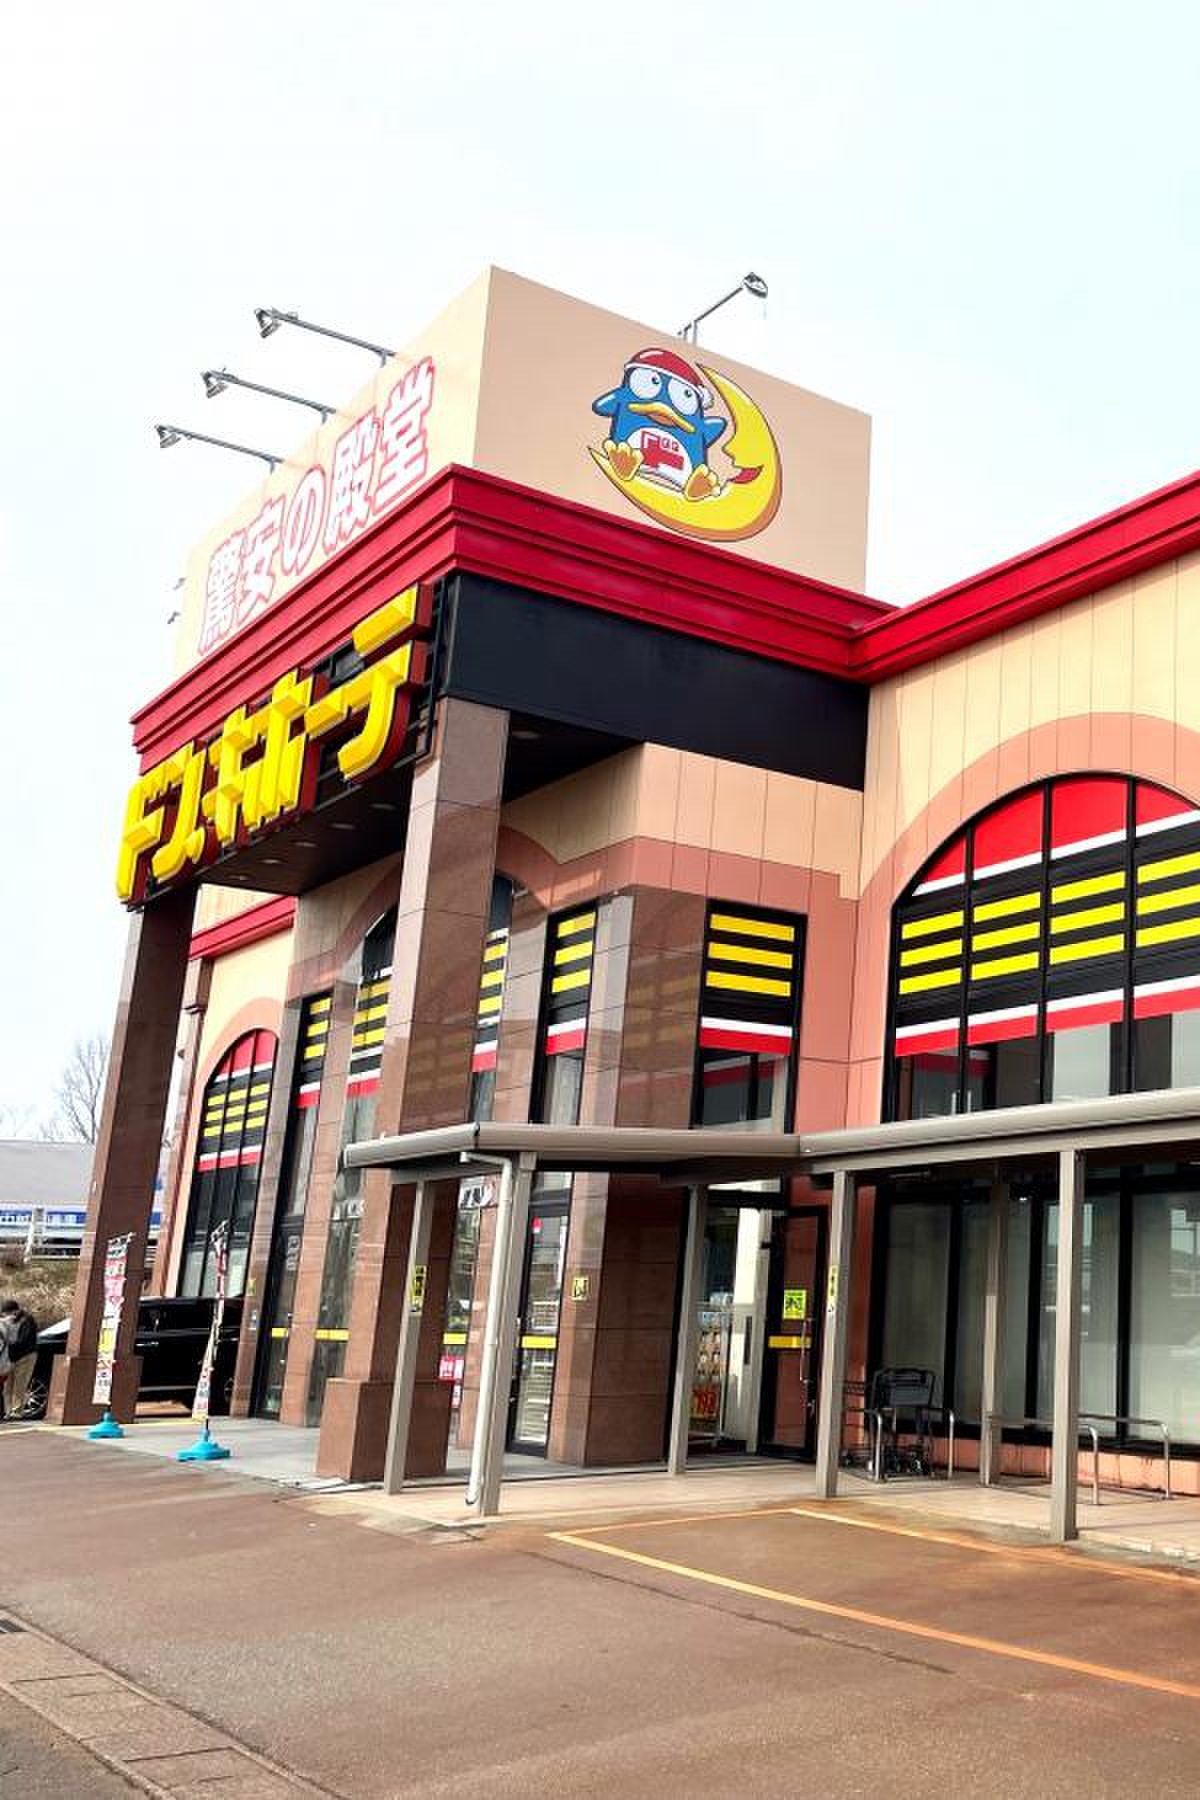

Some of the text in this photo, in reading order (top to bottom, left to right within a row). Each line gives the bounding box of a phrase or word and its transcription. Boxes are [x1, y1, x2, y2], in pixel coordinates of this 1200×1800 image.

[198, 356, 435, 656] 驚安の殿堂
